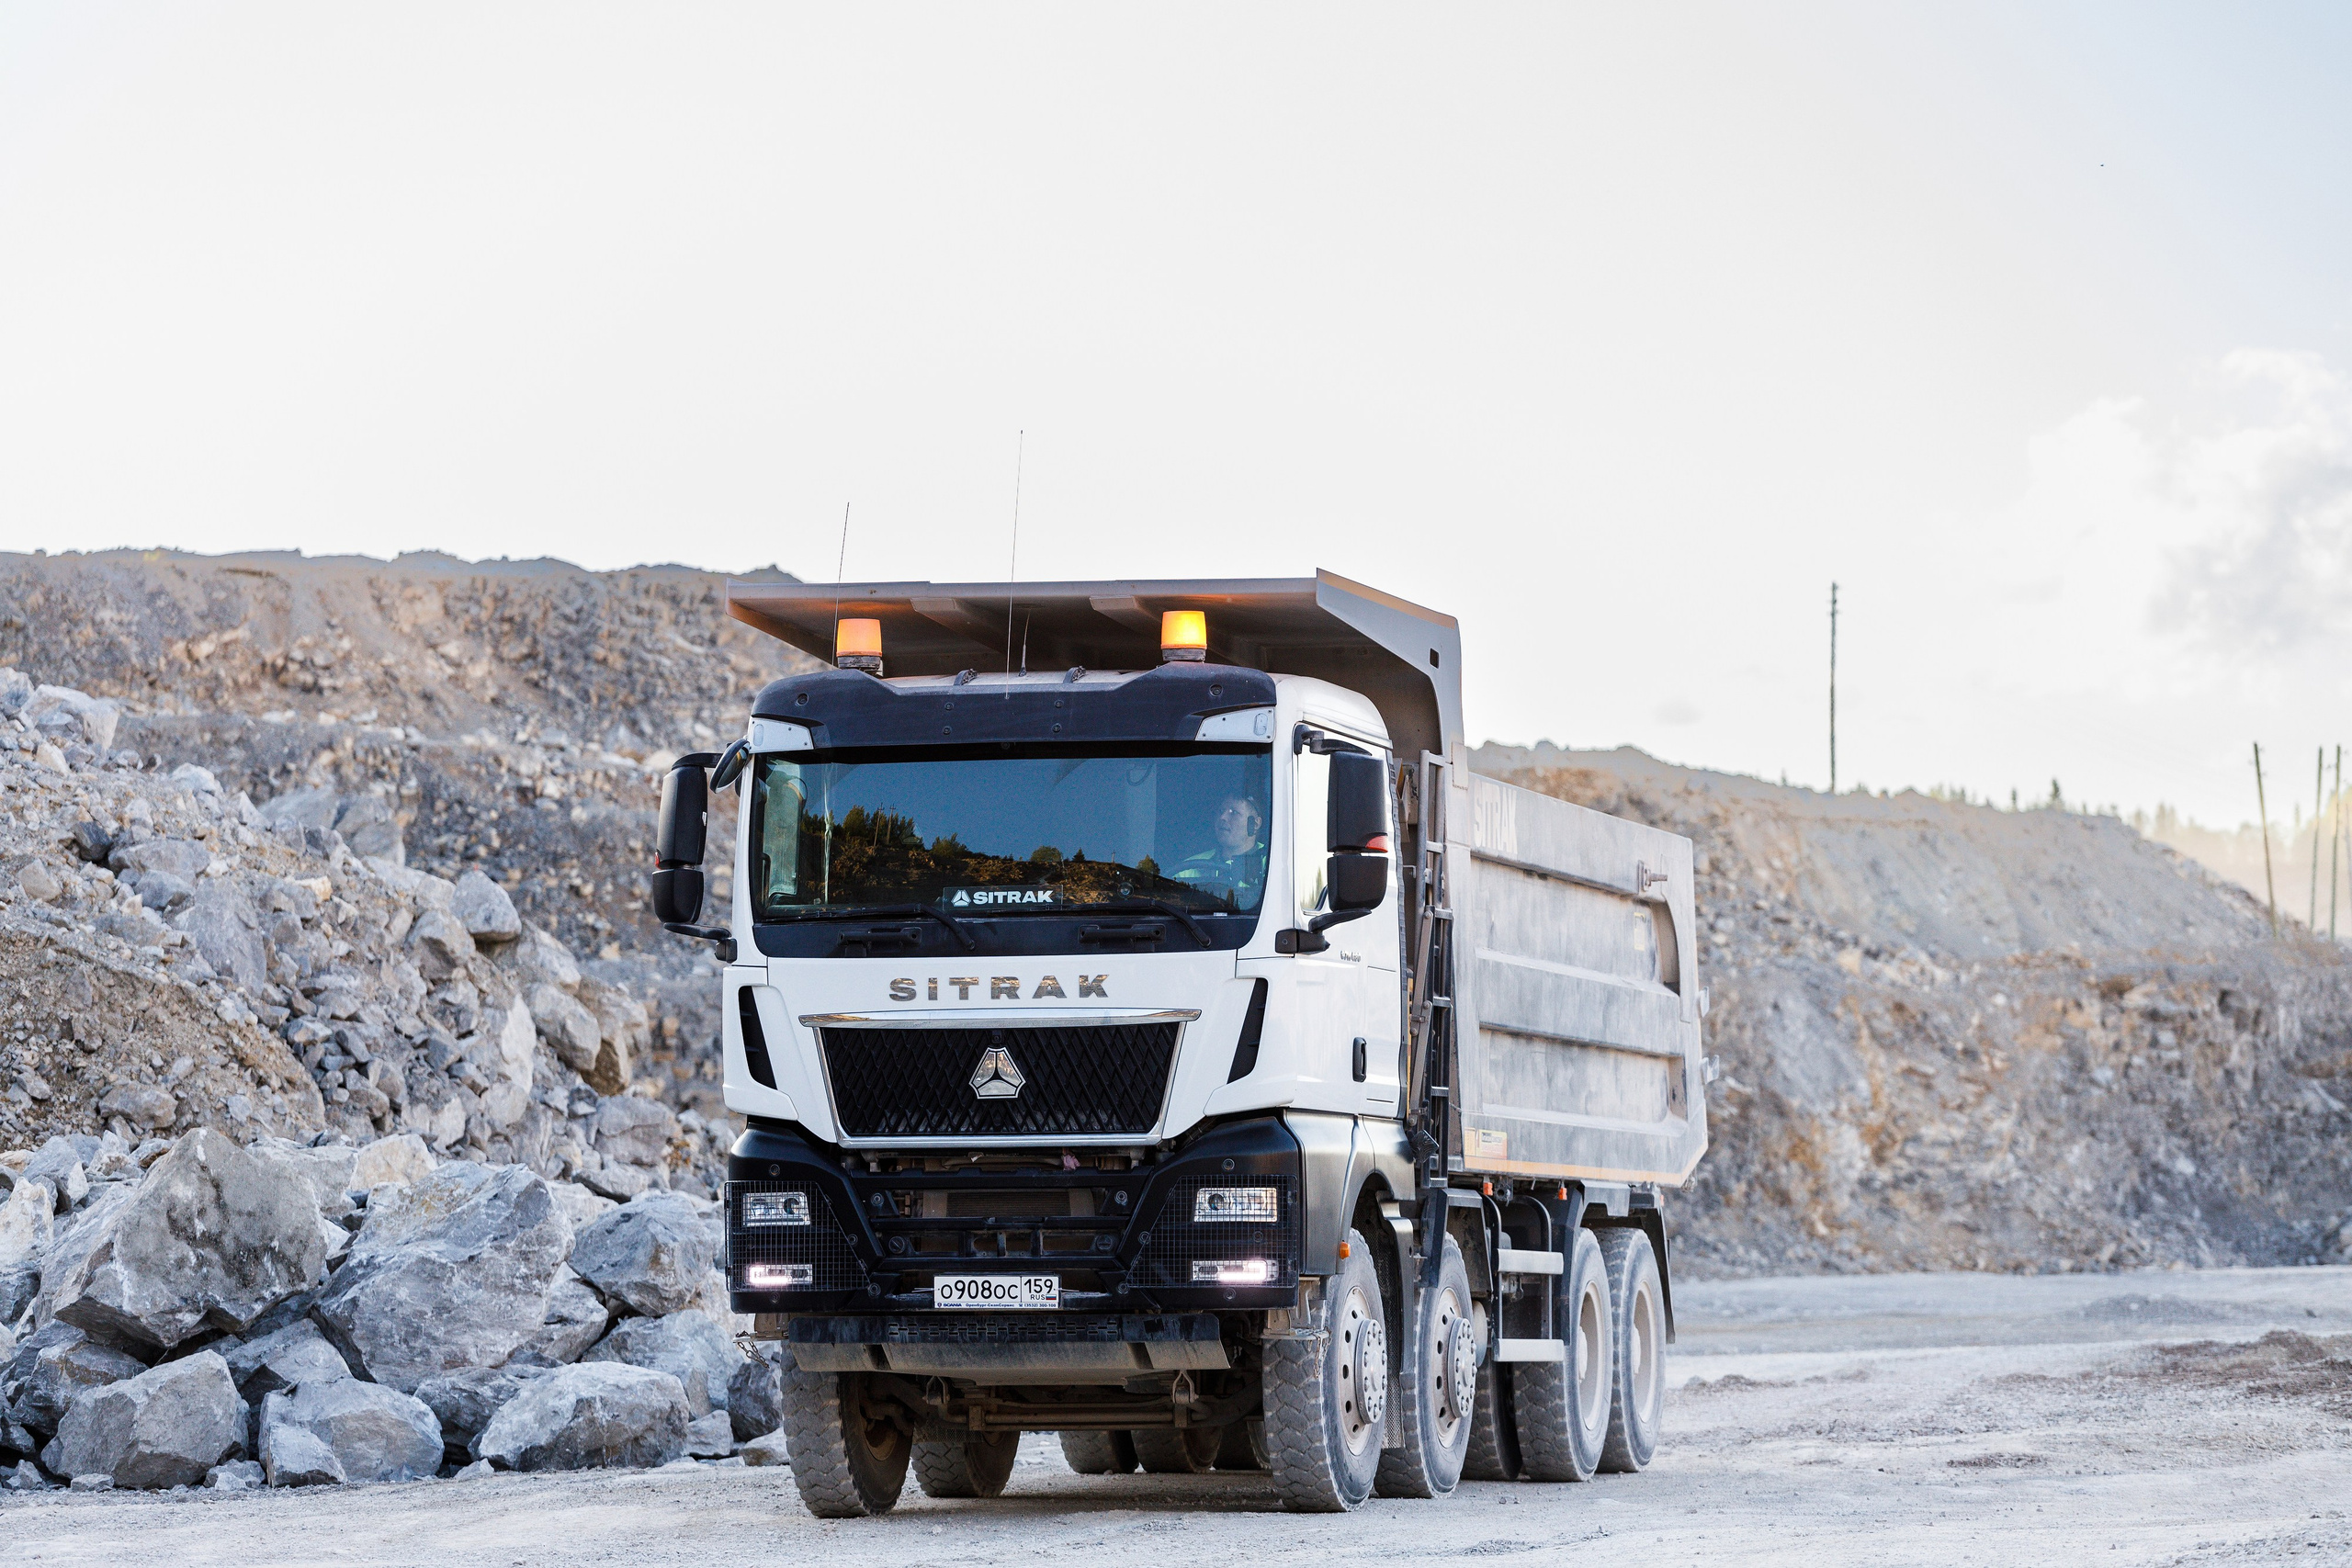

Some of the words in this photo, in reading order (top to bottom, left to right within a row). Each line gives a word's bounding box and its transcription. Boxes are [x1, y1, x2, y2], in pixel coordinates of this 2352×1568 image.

[1474, 778, 1518, 854] SITRAK
[973, 890, 1054, 905] SITRAK
[888, 975, 1110, 1002] SITRAK
[1023, 1279, 1054, 1293] 159
